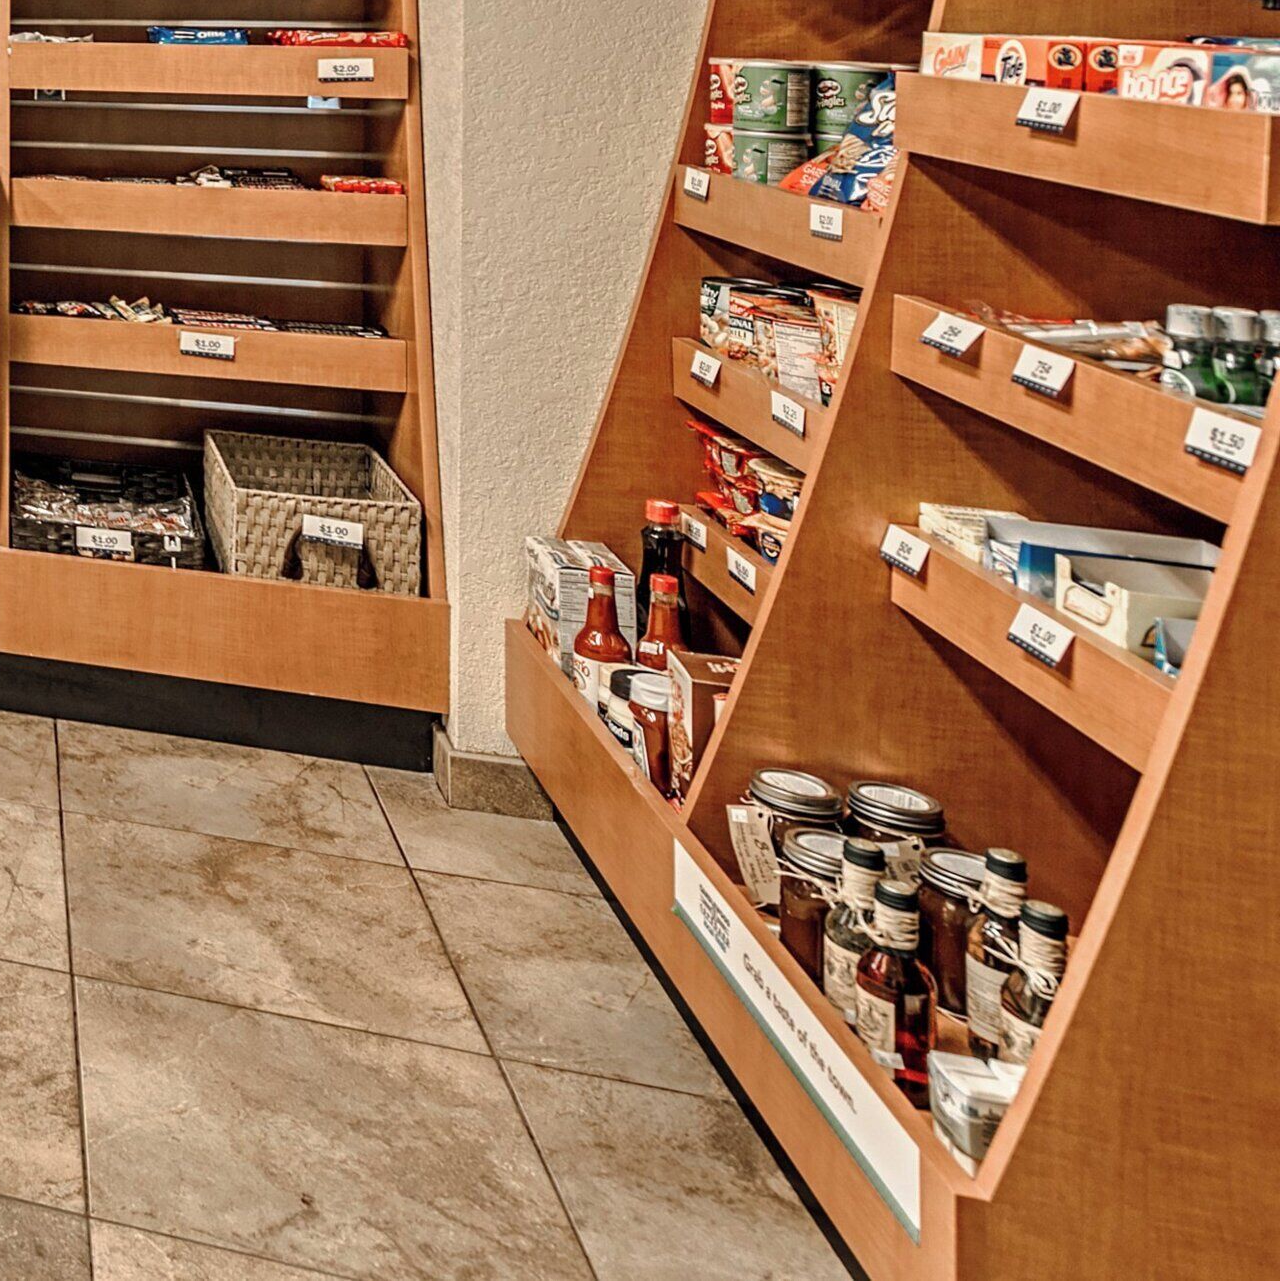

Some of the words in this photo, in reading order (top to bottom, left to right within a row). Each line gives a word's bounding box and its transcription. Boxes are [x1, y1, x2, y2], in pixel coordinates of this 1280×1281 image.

[933, 43, 971, 74] GAIN
[1001, 51, 1025, 80] Tide
[332, 65, 360, 73] $2.00
[1122, 67, 1190, 102] bounce
[1036, 99, 1063, 114] $1.00
[194, 337, 221, 350] $1.00
[318, 523, 349, 537] $1.00
[90, 533, 118, 546] $1.00
[1029, 622, 1058, 645] $1.00
